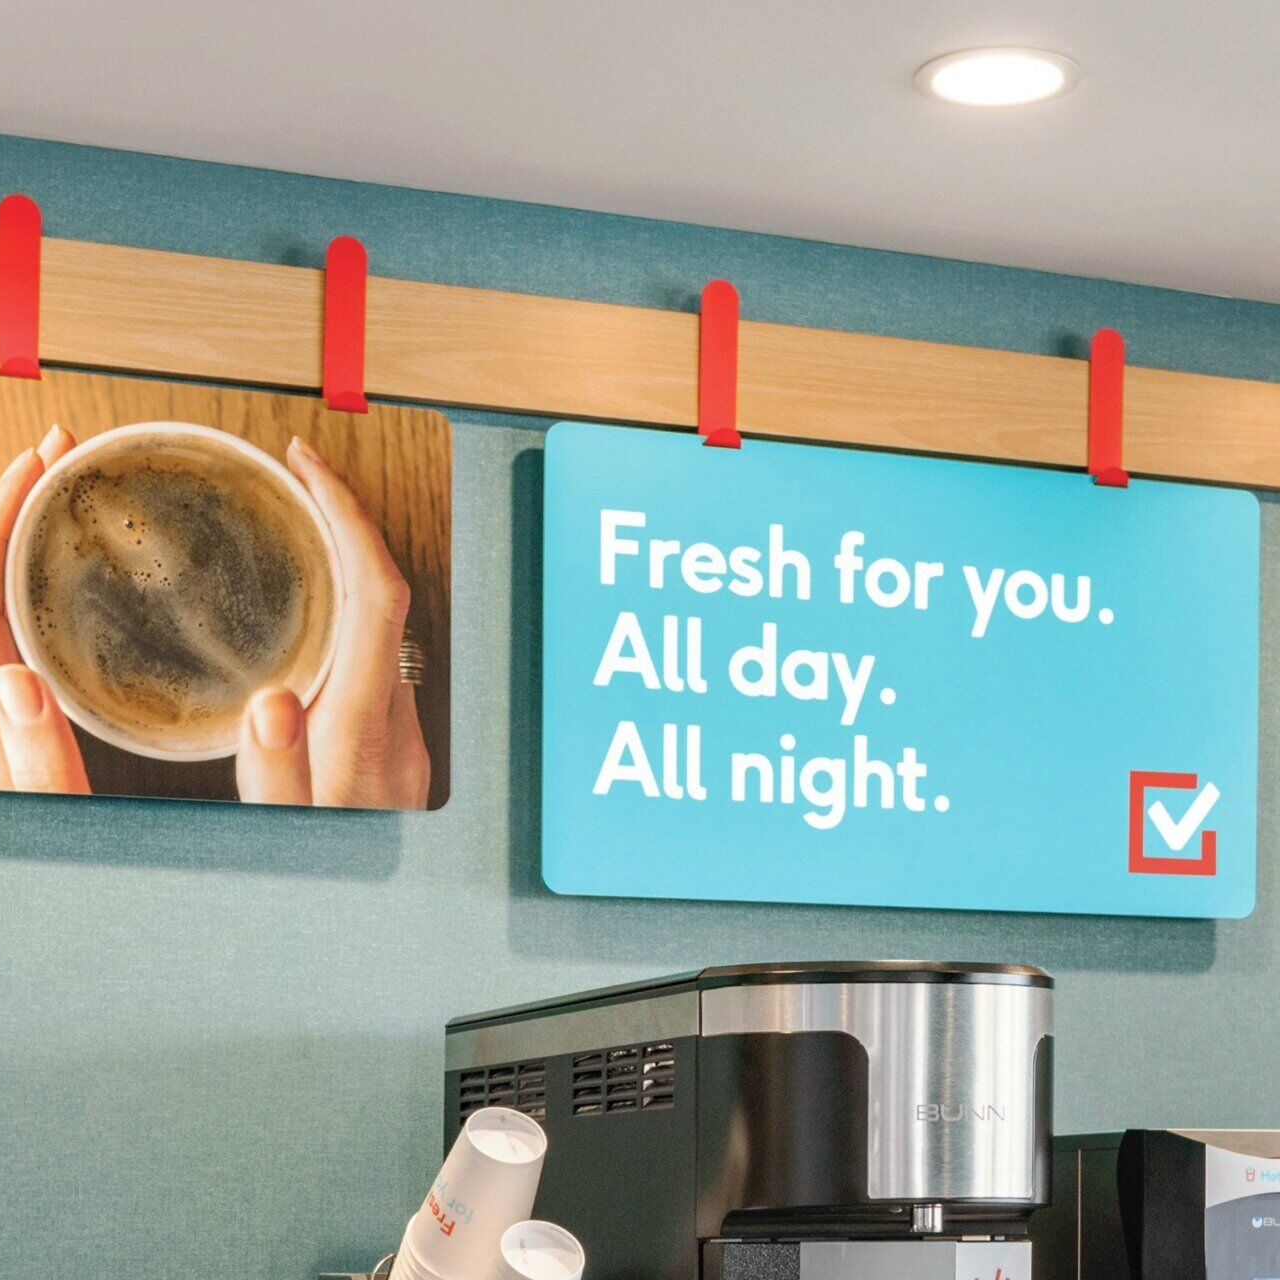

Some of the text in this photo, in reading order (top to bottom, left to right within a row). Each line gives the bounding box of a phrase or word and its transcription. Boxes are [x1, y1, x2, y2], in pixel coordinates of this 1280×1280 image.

[598, 508, 1116, 638] Fresh for you.
[592, 611, 898, 726] All day.
[592, 720, 952, 830] All night.
[916, 1104, 1006, 1121] BUNN
[1261, 1169, 1280, 1181] Hot
